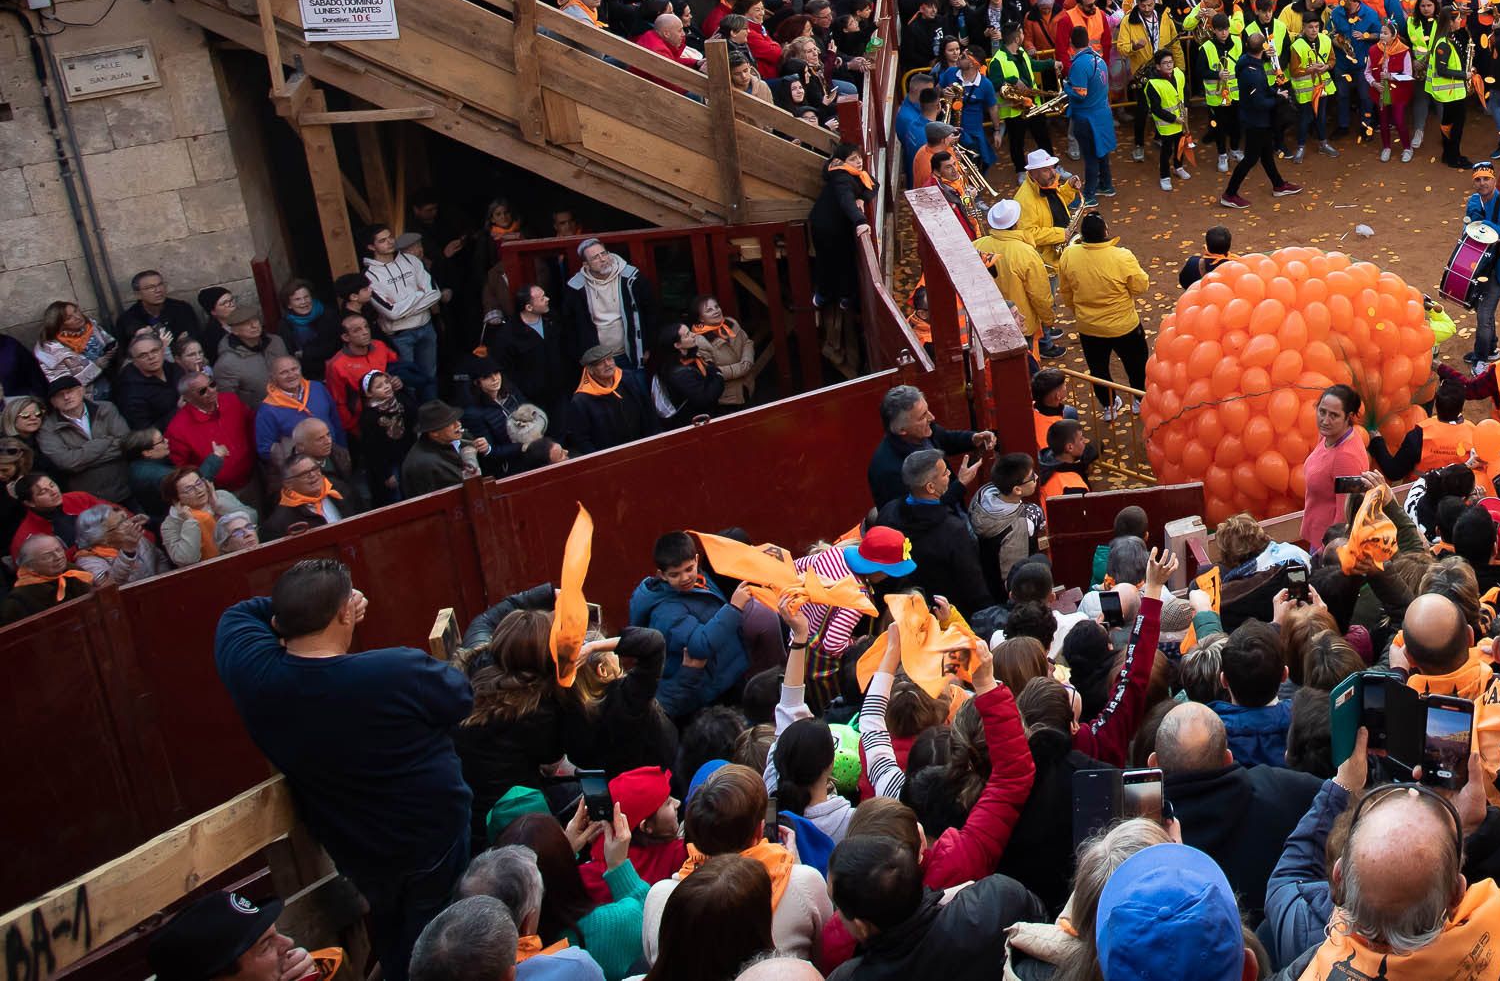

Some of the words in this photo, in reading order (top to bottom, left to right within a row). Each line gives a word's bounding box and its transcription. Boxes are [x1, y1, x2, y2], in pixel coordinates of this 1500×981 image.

[313, 7, 341, 15] LUNES
[348, 6, 382, 14] MARTES
[351, 14, 364, 22] 10
[89, 76, 108, 85] SAN
